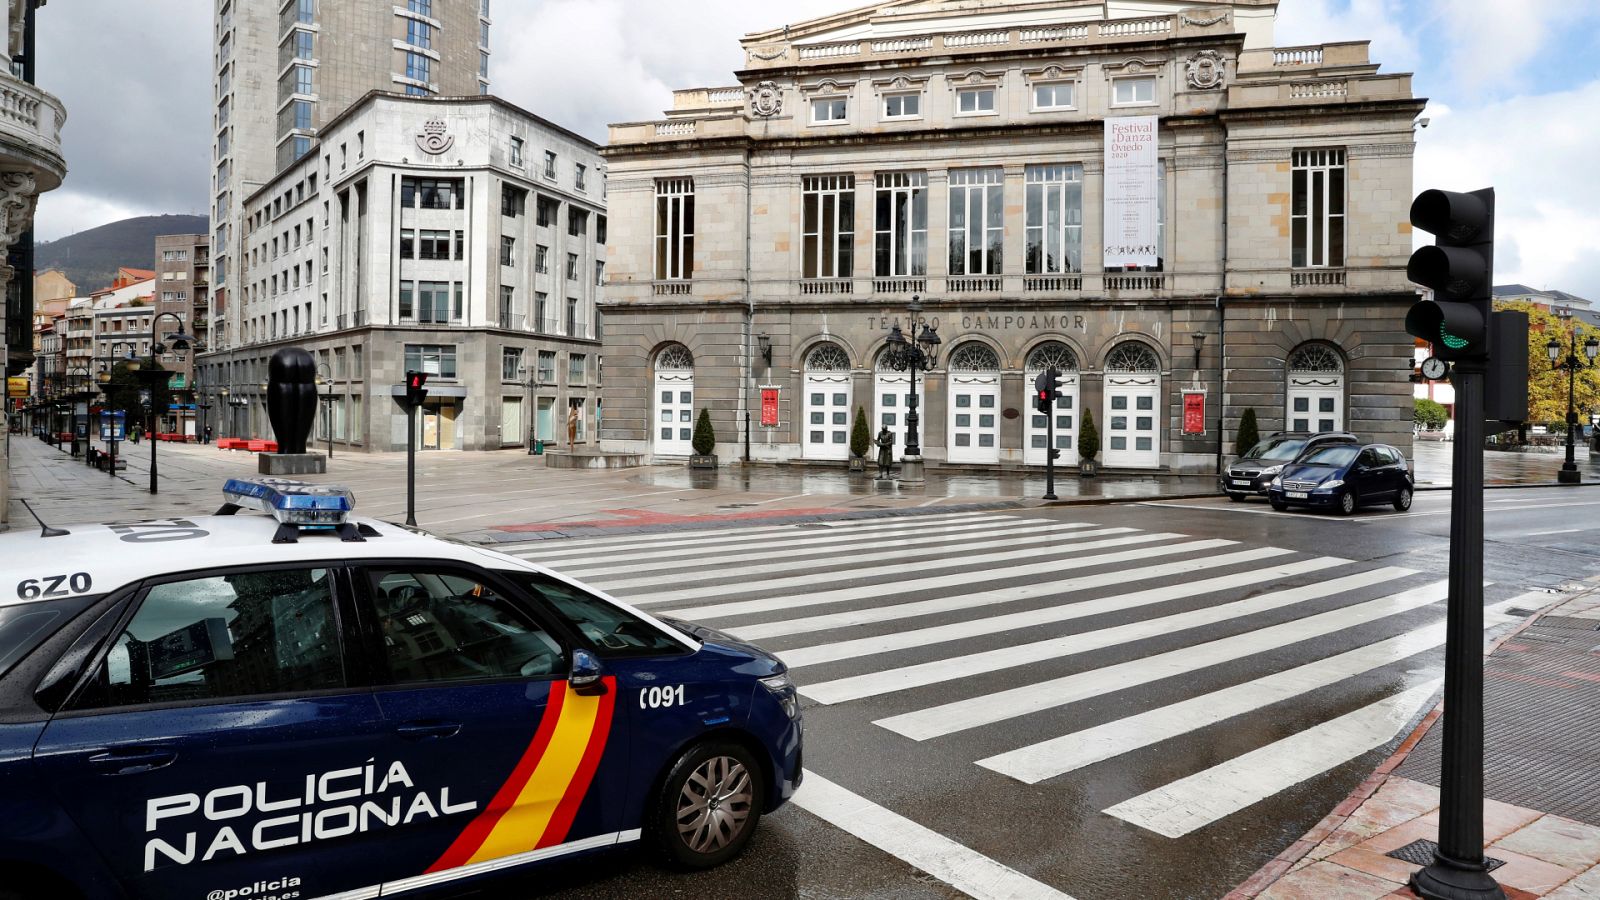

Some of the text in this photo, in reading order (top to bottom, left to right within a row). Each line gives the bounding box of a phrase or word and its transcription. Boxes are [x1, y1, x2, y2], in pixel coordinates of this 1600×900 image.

[1111, 122, 1153, 134] Festival
[1116, 132, 1152, 143] Danza
[1111, 142, 1143, 152] Oviedo
[867, 315, 1085, 330] TEATRO CAMPOAMOR
[16, 571, 93, 601] 6Z0
[145, 756, 415, 832] POLICÍA
[143, 786, 478, 873] NACIONAL
[206, 876, 301, 900] @policia
